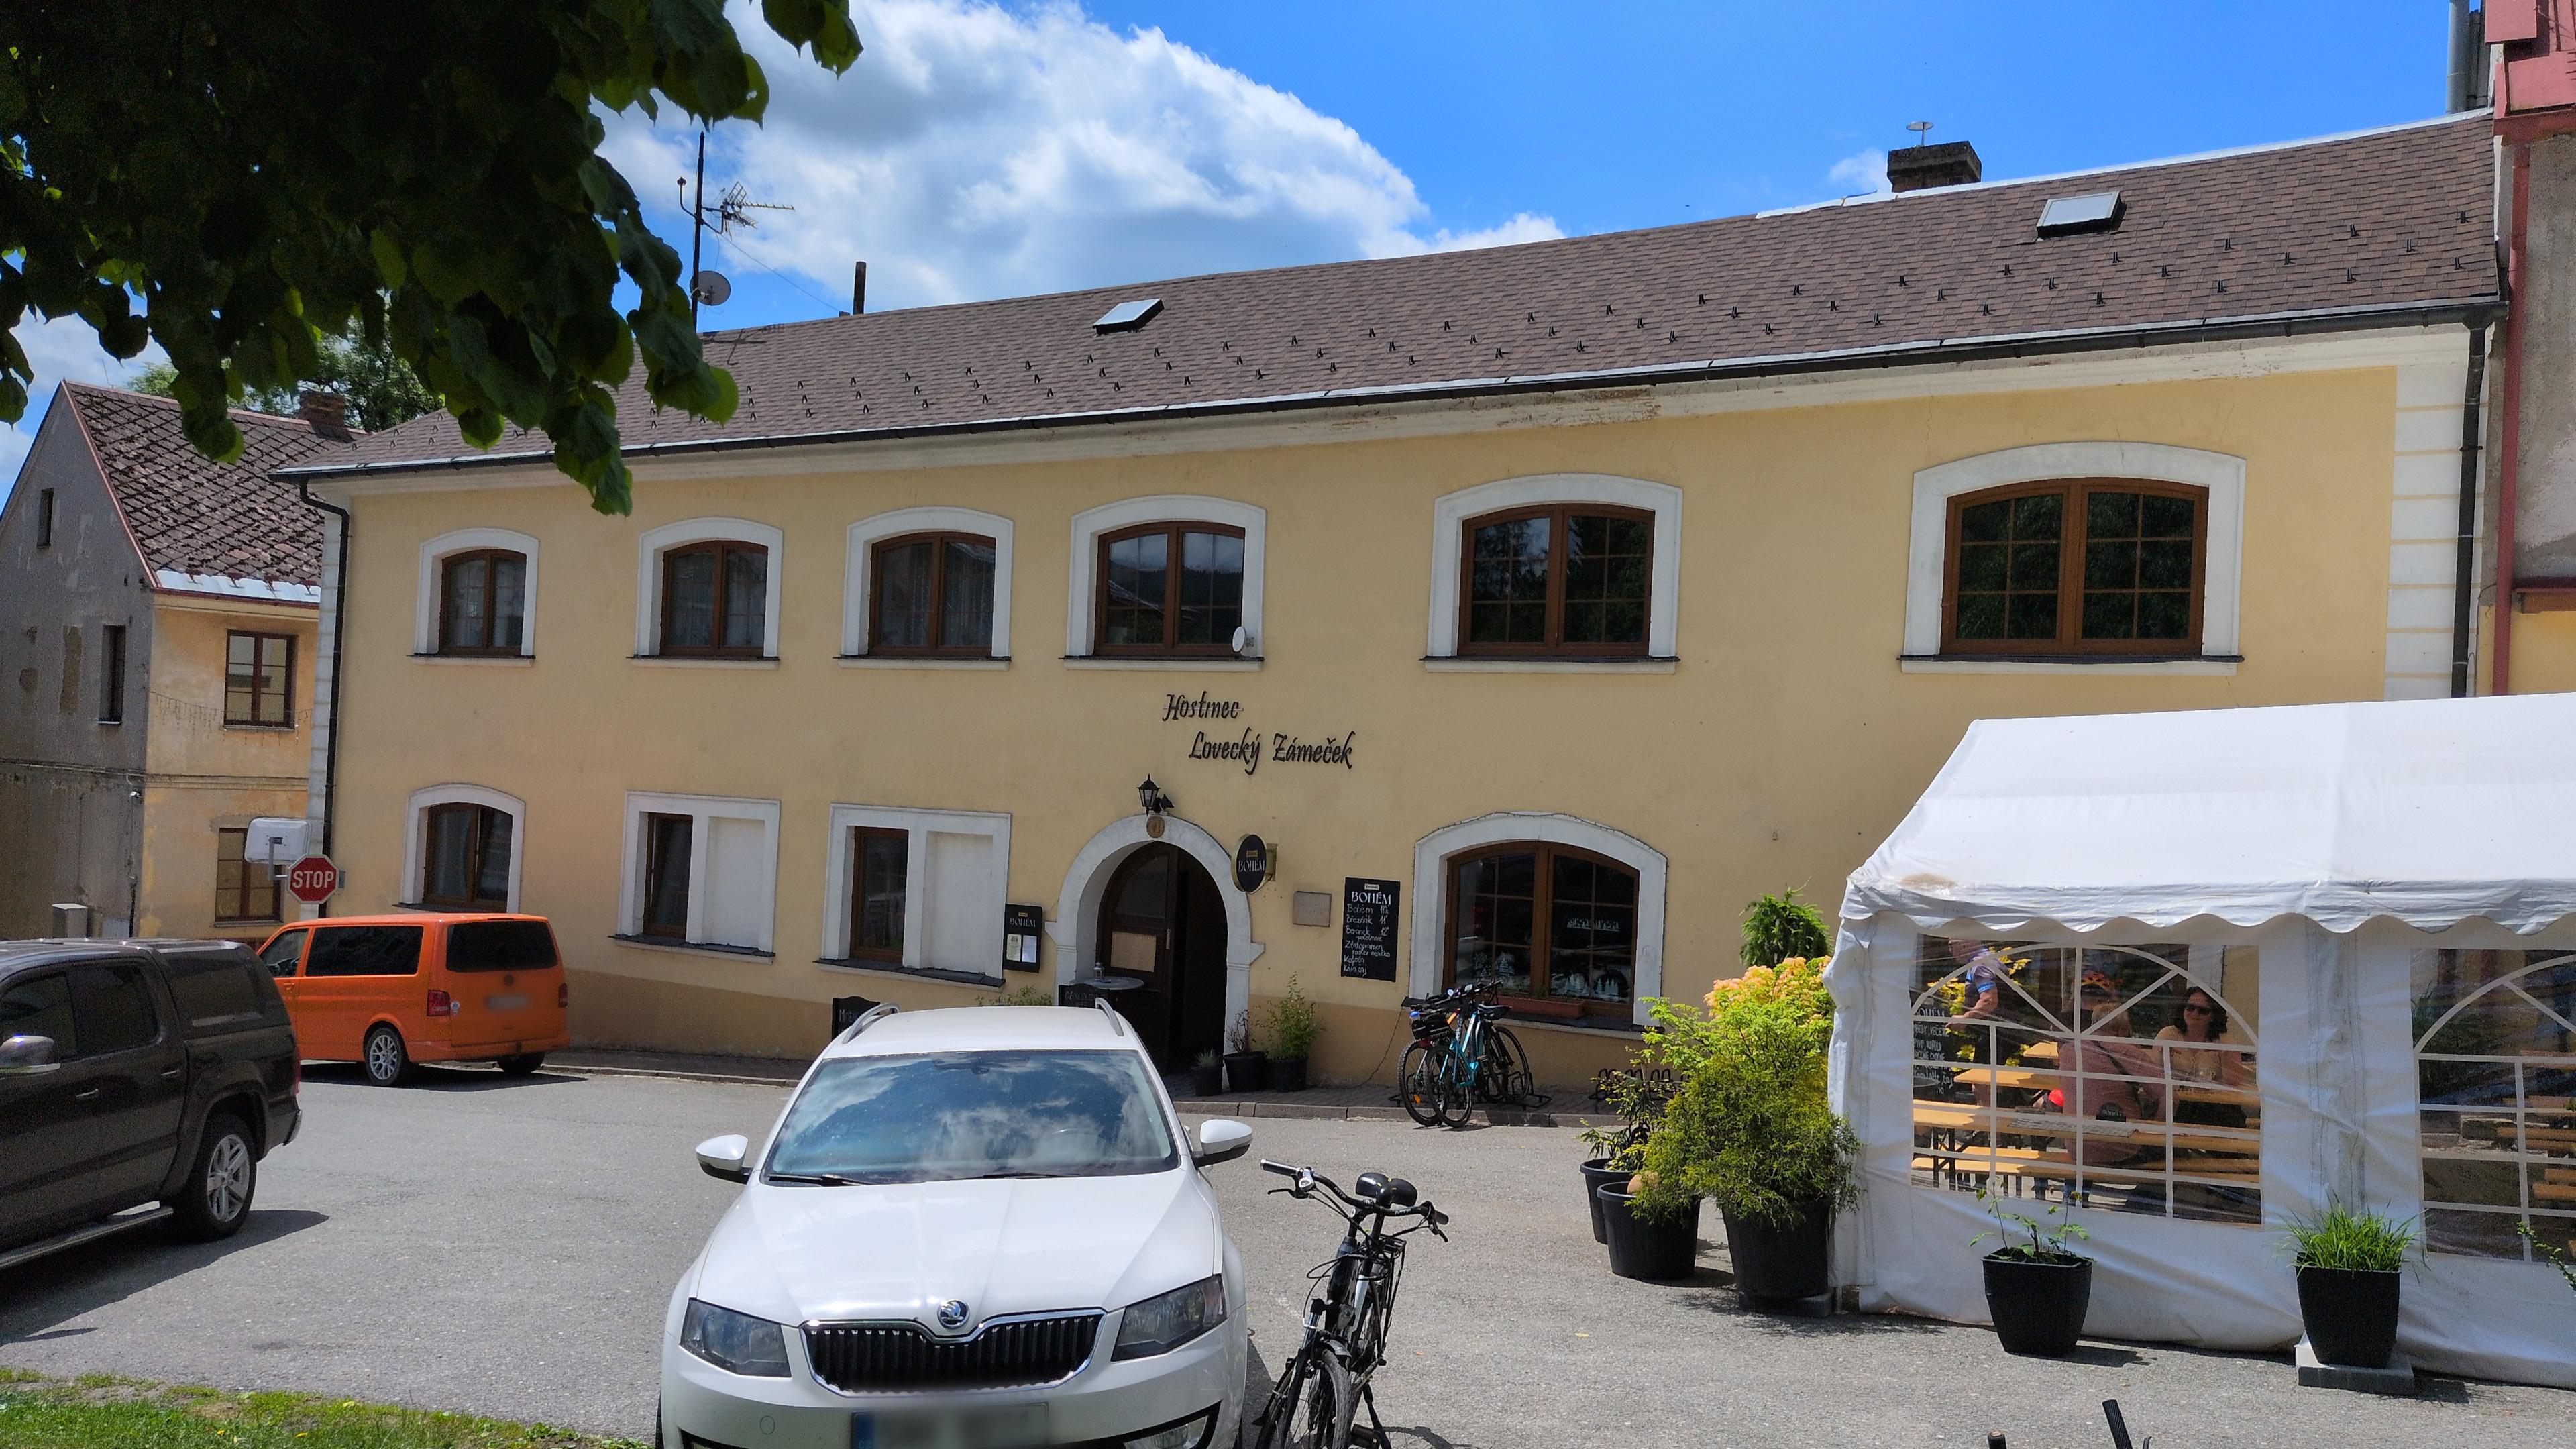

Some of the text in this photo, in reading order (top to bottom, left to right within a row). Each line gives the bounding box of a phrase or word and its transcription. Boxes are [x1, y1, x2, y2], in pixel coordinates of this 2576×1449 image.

[1162, 691, 1240, 721] Hostinec
[1189, 727, 1356, 775] Lovecký Zámeček
[292, 871, 334, 888] STOP
[1351, 891, 1391, 906] BOHÉM
